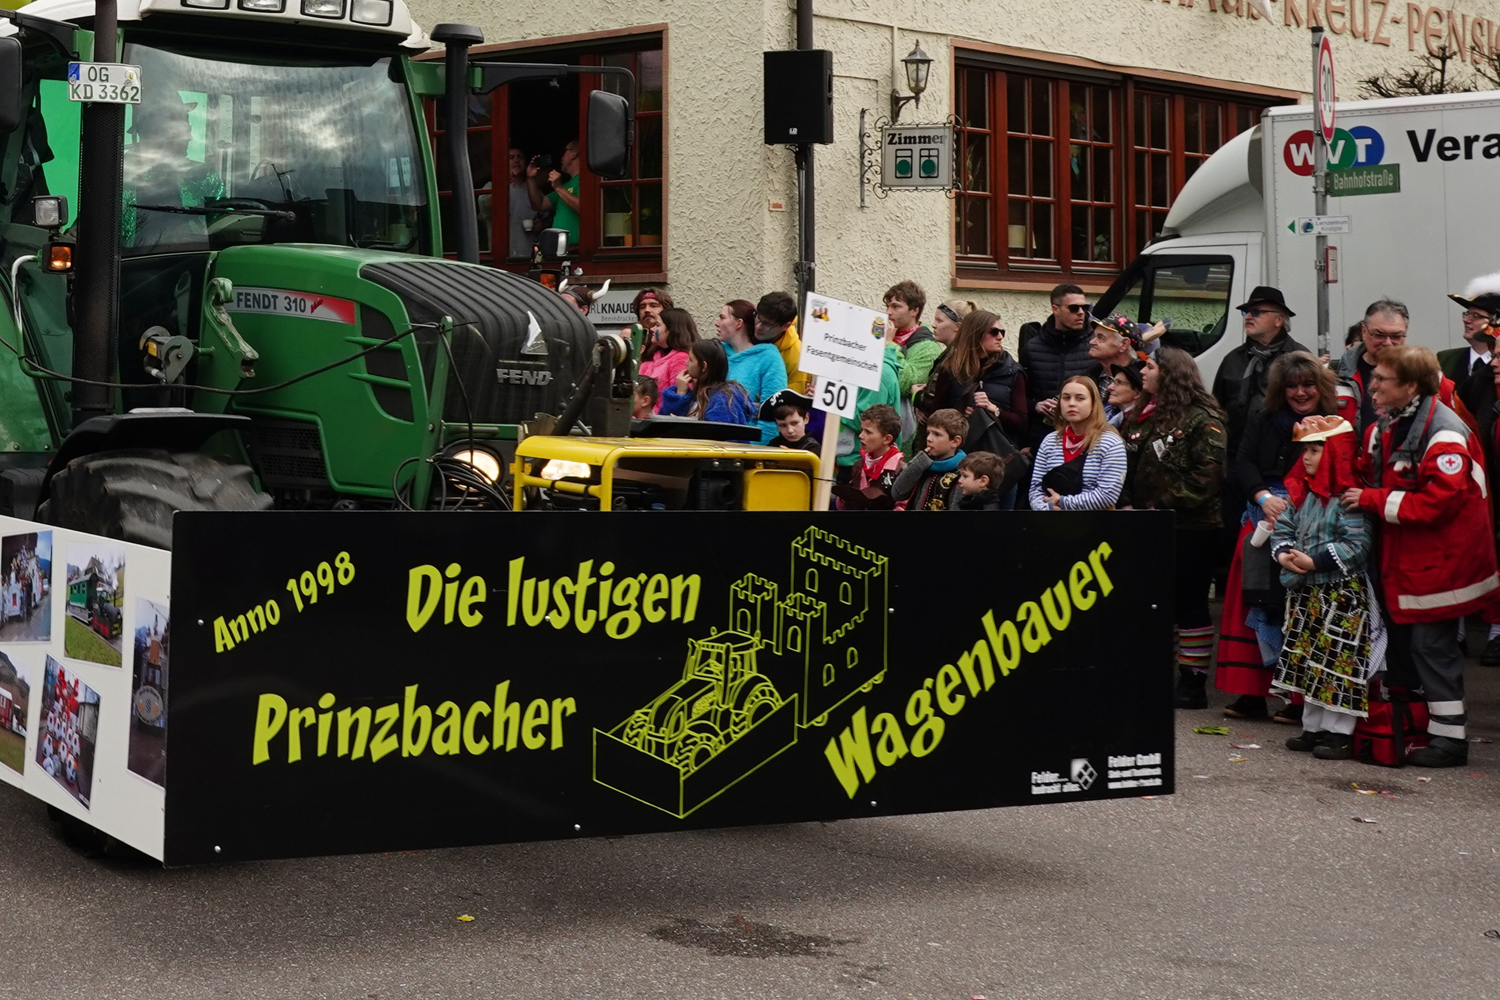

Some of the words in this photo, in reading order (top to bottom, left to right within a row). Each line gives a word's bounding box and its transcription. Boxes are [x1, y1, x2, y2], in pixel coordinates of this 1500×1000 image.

[88, 66, 109, 82] OG
[71, 84, 93, 100] KD
[98, 85, 139, 101] 3362
[1322, 64, 1332, 114] 30
[887, 133, 947, 146] Zimmer
[1289, 138, 1372, 168] WVT
[1333, 171, 1394, 190] Bahnhofstraße
[235, 291, 279, 311] FENDT
[284, 295, 308, 313] 310
[823, 332, 868, 352] Prinzbacher
[806, 345, 879, 373] Fasentgemeinschaft
[821, 381, 849, 411] 50
[213, 599, 281, 655] Anno
[286, 550, 358, 614] 1998
[405, 563, 487, 633] Die
[506, 556, 702, 641] lustigen
[823, 539, 1117, 800] Wagenbauer
[252, 678, 577, 767] Prinzbacher
